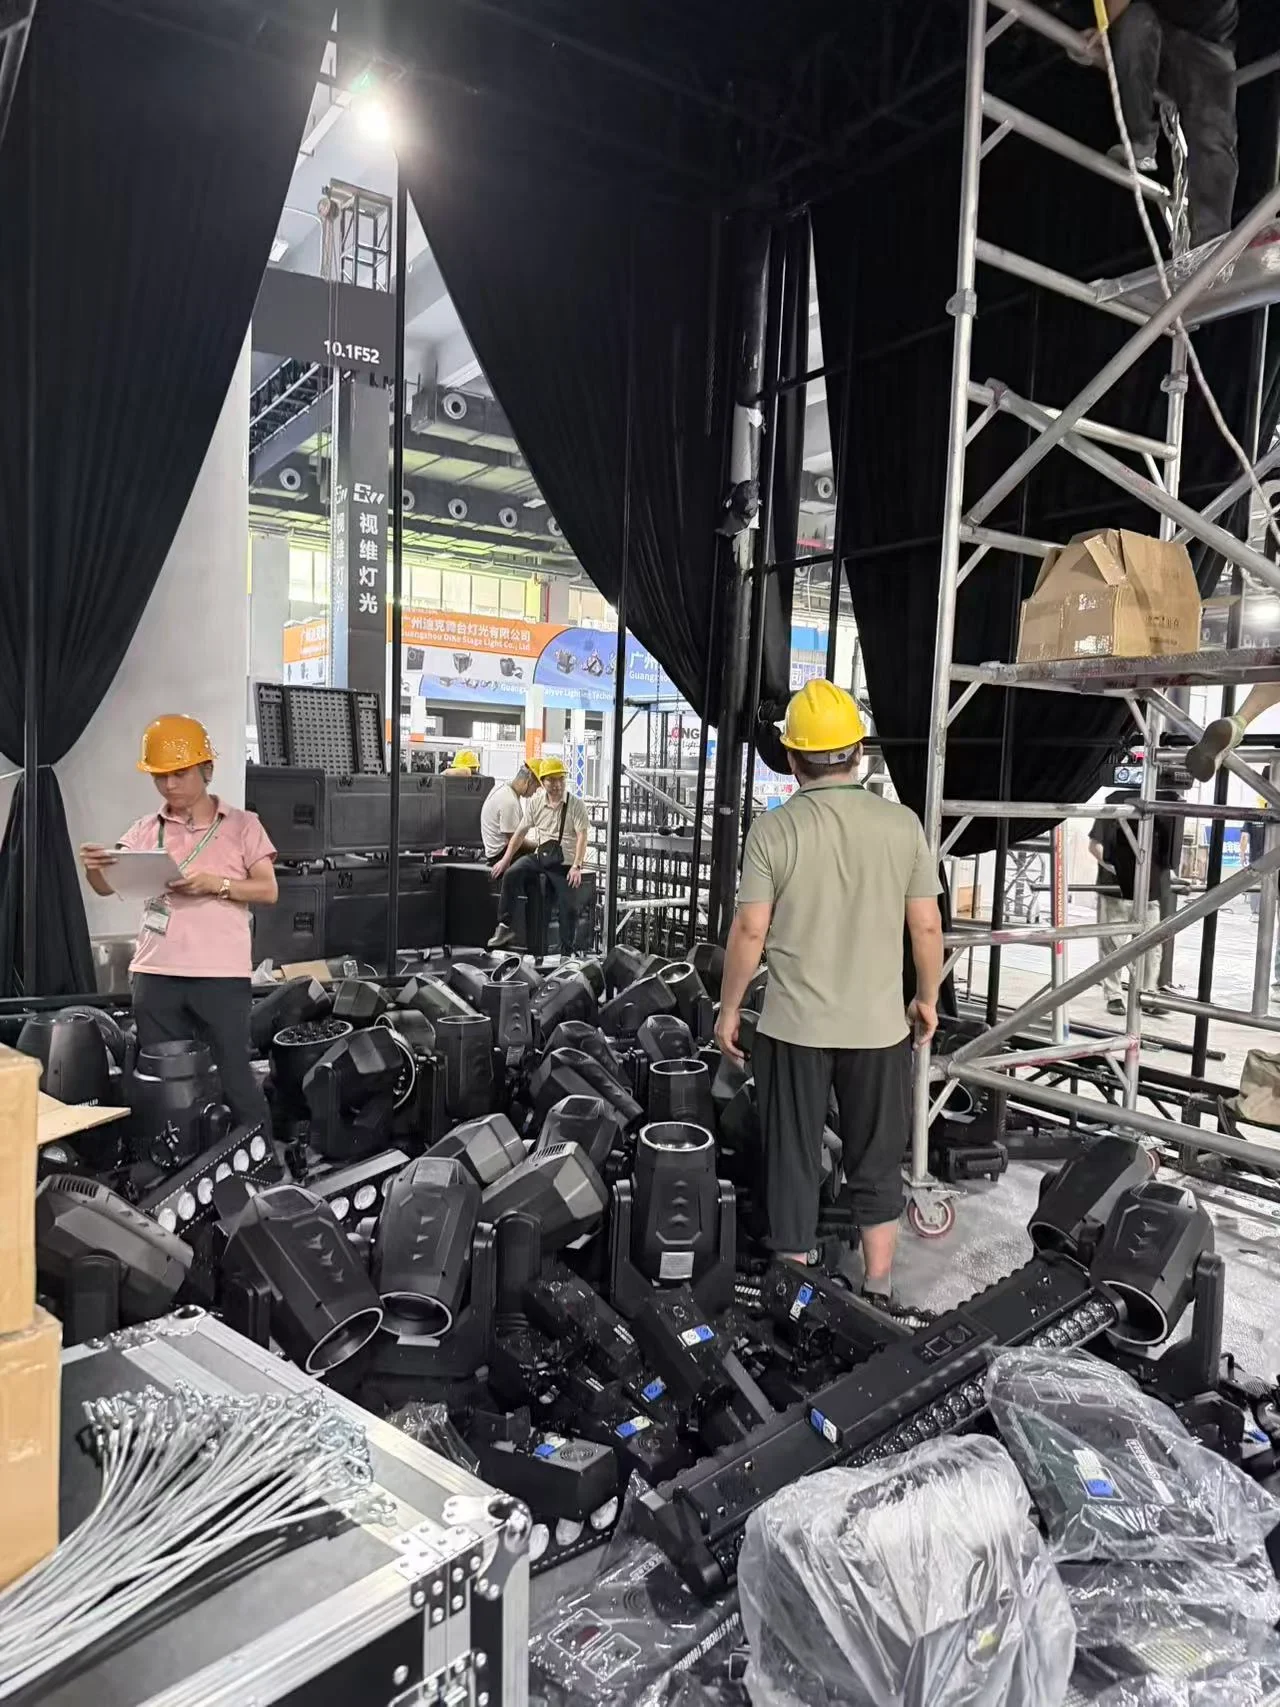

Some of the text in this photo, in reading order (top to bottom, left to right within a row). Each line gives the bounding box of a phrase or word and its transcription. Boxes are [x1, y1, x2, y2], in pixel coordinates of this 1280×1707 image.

[324, 340, 380, 364] 10.1F52
[359, 512, 379, 614] 视维灯光
[701, 1623, 726, 1653] STROBE
